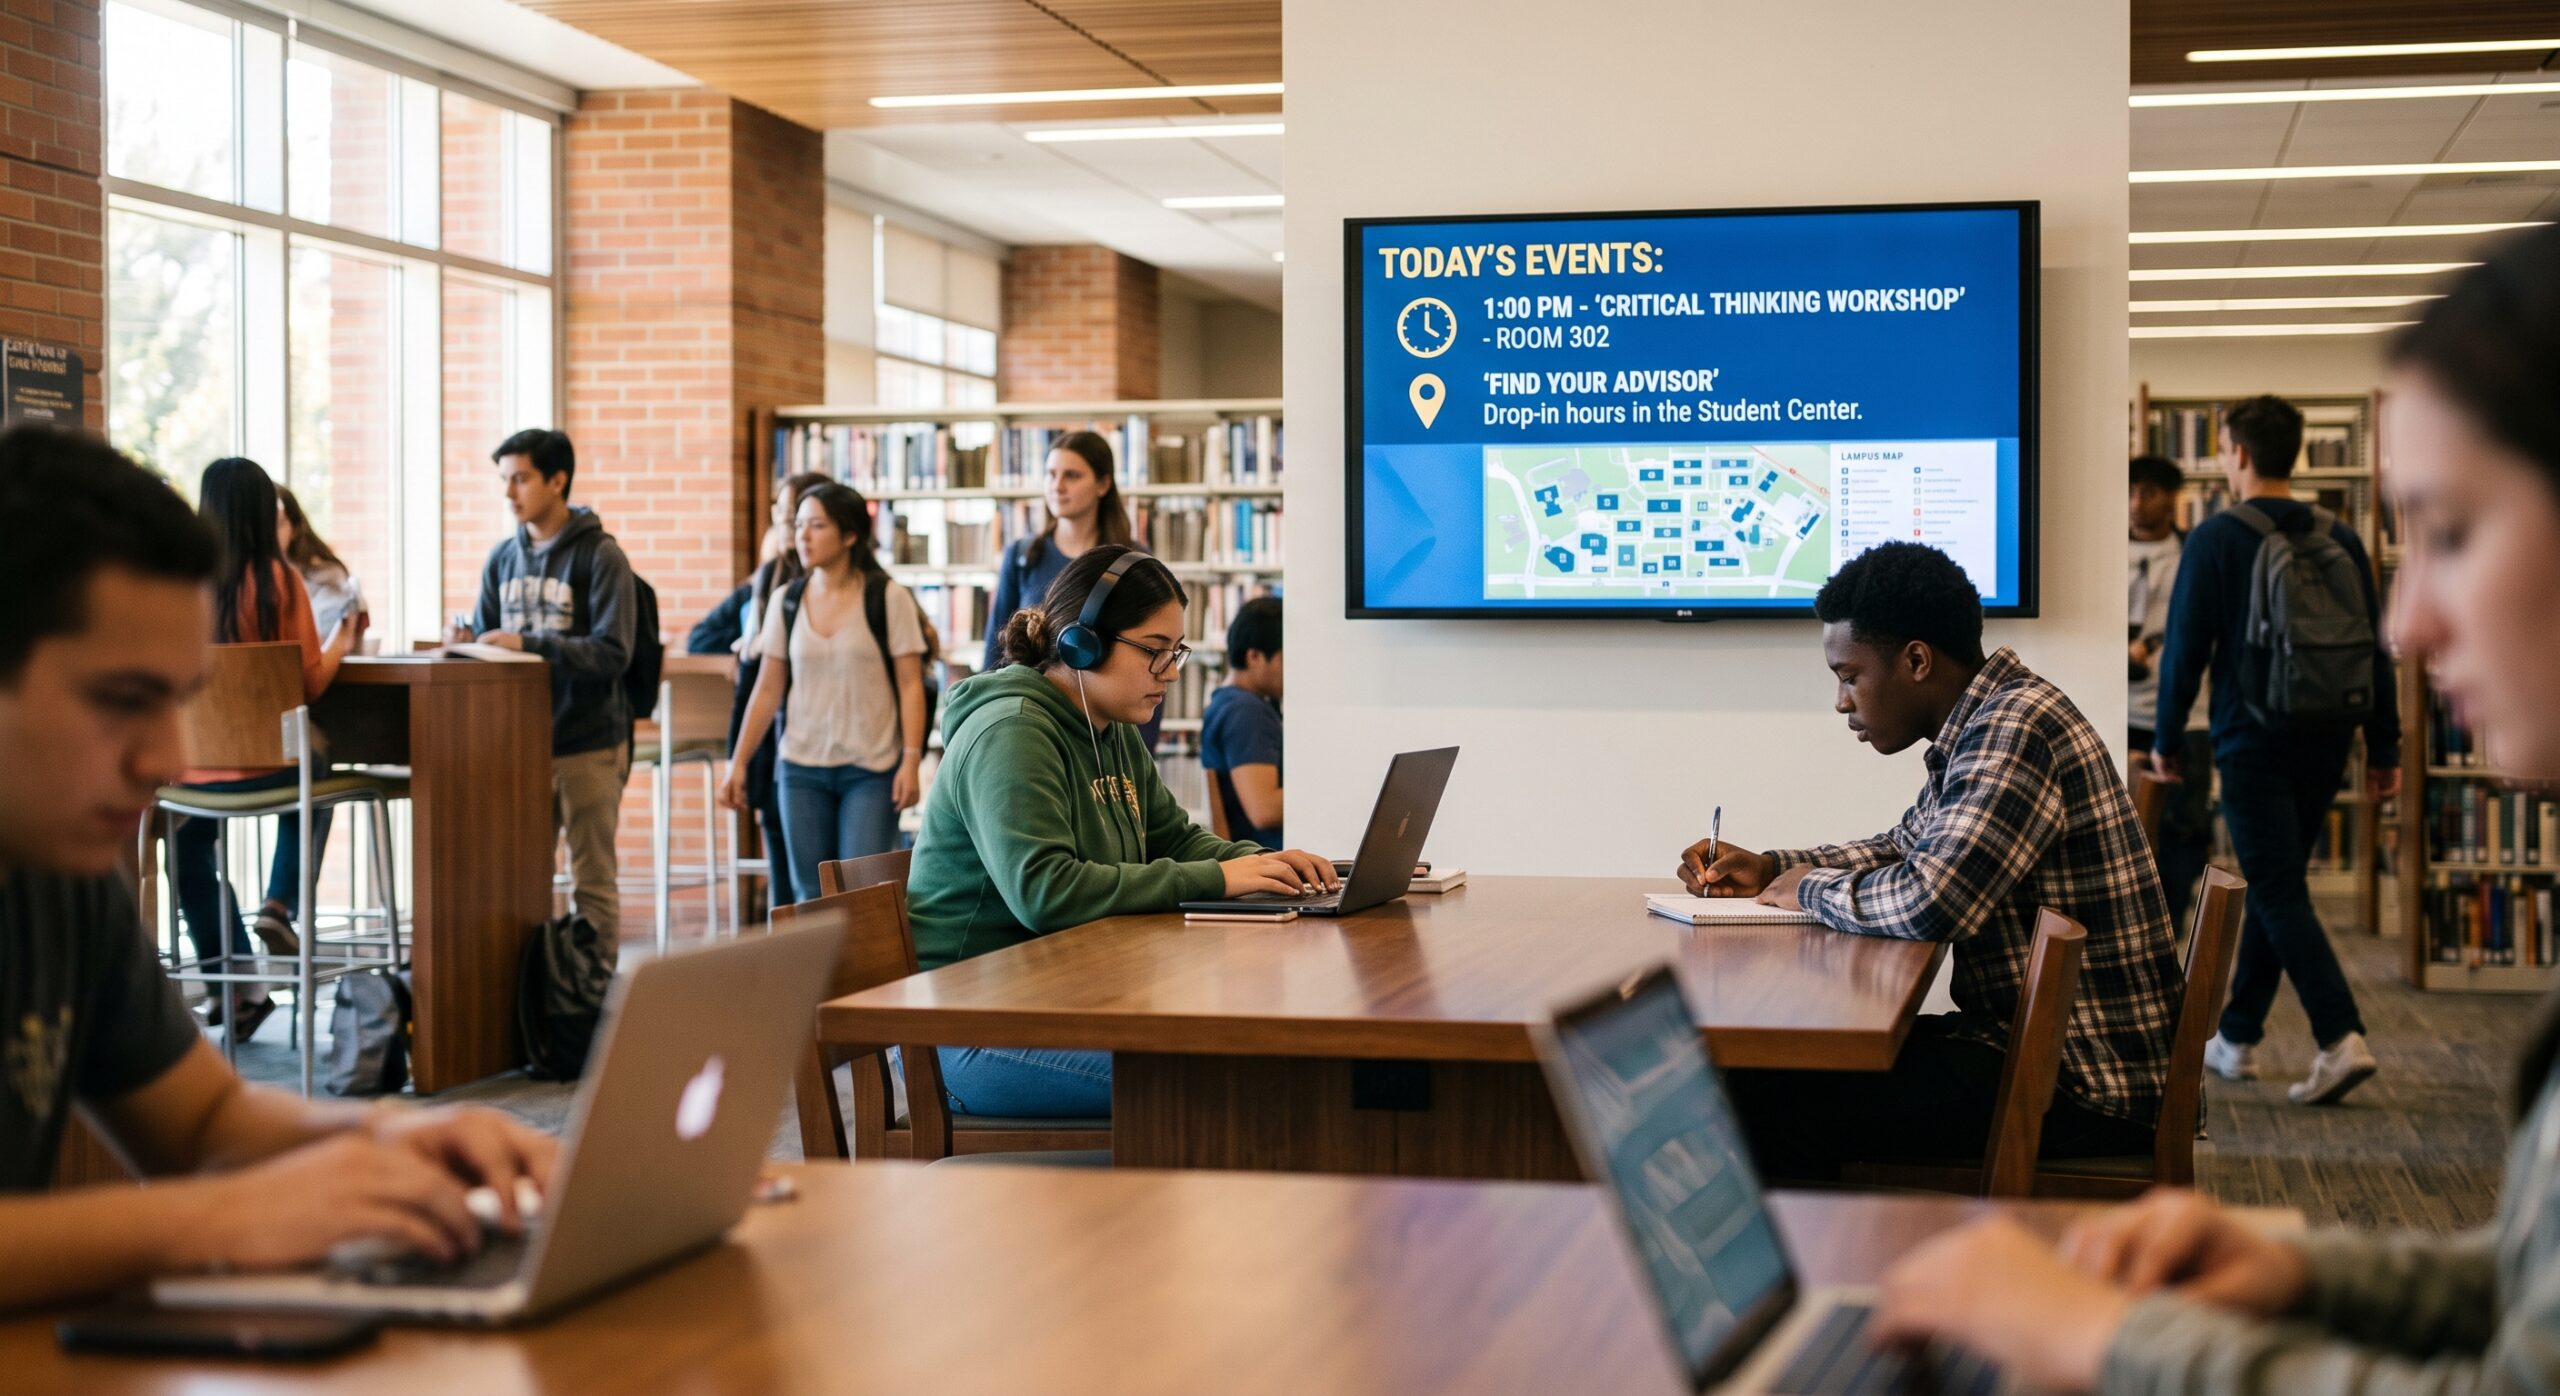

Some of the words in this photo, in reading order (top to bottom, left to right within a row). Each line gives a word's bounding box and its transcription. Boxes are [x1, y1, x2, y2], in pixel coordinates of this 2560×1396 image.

[1378, 243, 1516, 279] TODAY'S
[1526, 241, 1664, 276] EVENTS:
[1483, 296, 1531, 320] 1:00
[1537, 295, 1573, 319] PM
[1594, 293, 1705, 317] 'CRITICAL
[1709, 290, 1821, 315] THINKING
[1826, 286, 1966, 313] WORKSHOP'
[1496, 326, 1562, 349] ROOM
[1569, 325, 1610, 348] 302
[1483, 372, 1541, 395] 'FIND
[1546, 371, 1608, 394] YOUR
[1612, 368, 1719, 393] ADVISOR'
[1484, 401, 1559, 430] Drop-in
[1566, 400, 1626, 424] hours
[1632, 400, 1651, 423] in
[1657, 399, 1692, 423] the
[1698, 398, 1781, 422] Student
[1787, 398, 1863, 421] Center.
[1882, 451, 1904, 461] MAP
